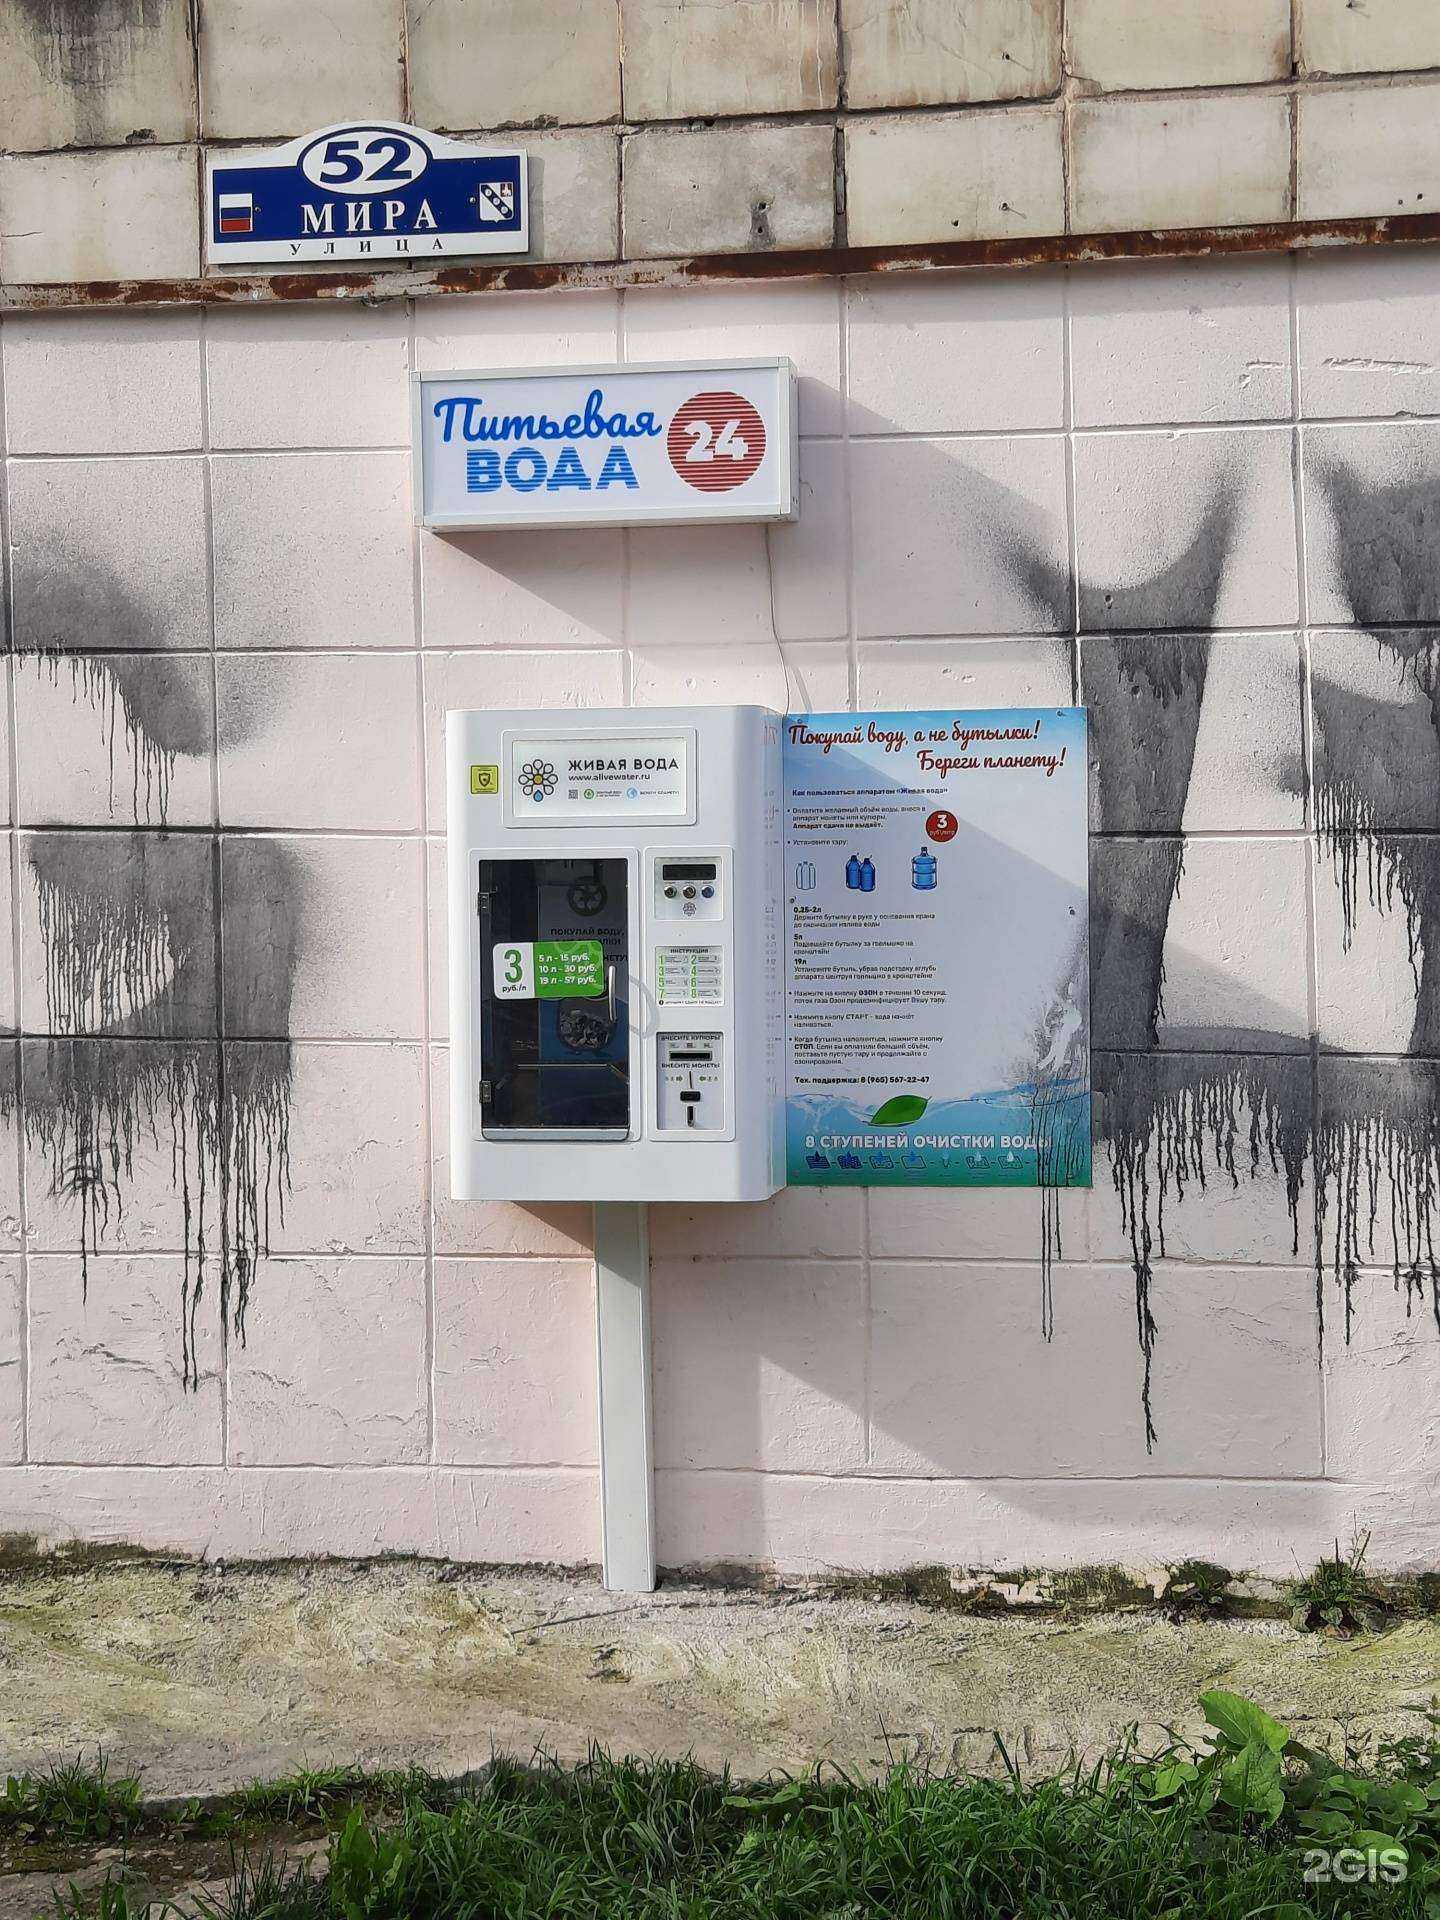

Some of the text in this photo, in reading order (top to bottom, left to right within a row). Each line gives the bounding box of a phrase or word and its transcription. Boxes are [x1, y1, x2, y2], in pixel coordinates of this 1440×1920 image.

[320, 138, 412, 184] 52
[301, 199, 438, 234] МИРА
[289, 238, 443, 256] УЛИЦА
[433, 389, 662, 443] Питьевая
[684, 421, 749, 462] 24
[466, 446, 640, 494] ВОДА
[789, 719, 1041, 754] Покупай воду, а не бутылки!
[568, 758, 679, 772] ЖИВАЯ ВОДА
[916, 747, 1067, 778] Береги планету!
[568, 773, 650, 781] www.alivewater.ru
[936, 814, 948, 829] 3
[504, 949, 523, 983] 3
[571, 952, 590, 963] руб.
[577, 963, 597, 974] руб.
[502, 984, 527, 993] руб./л
[539, 977, 549, 985] 19
[564, 976, 575, 984] 57
[577, 975, 597, 985] руб.
[867, 1076, 888, 1084] (965)
[805, 1132, 1050, 1150] 8 СТУПЕНЕЙ ОЧИСТКИ ВОДЫ
